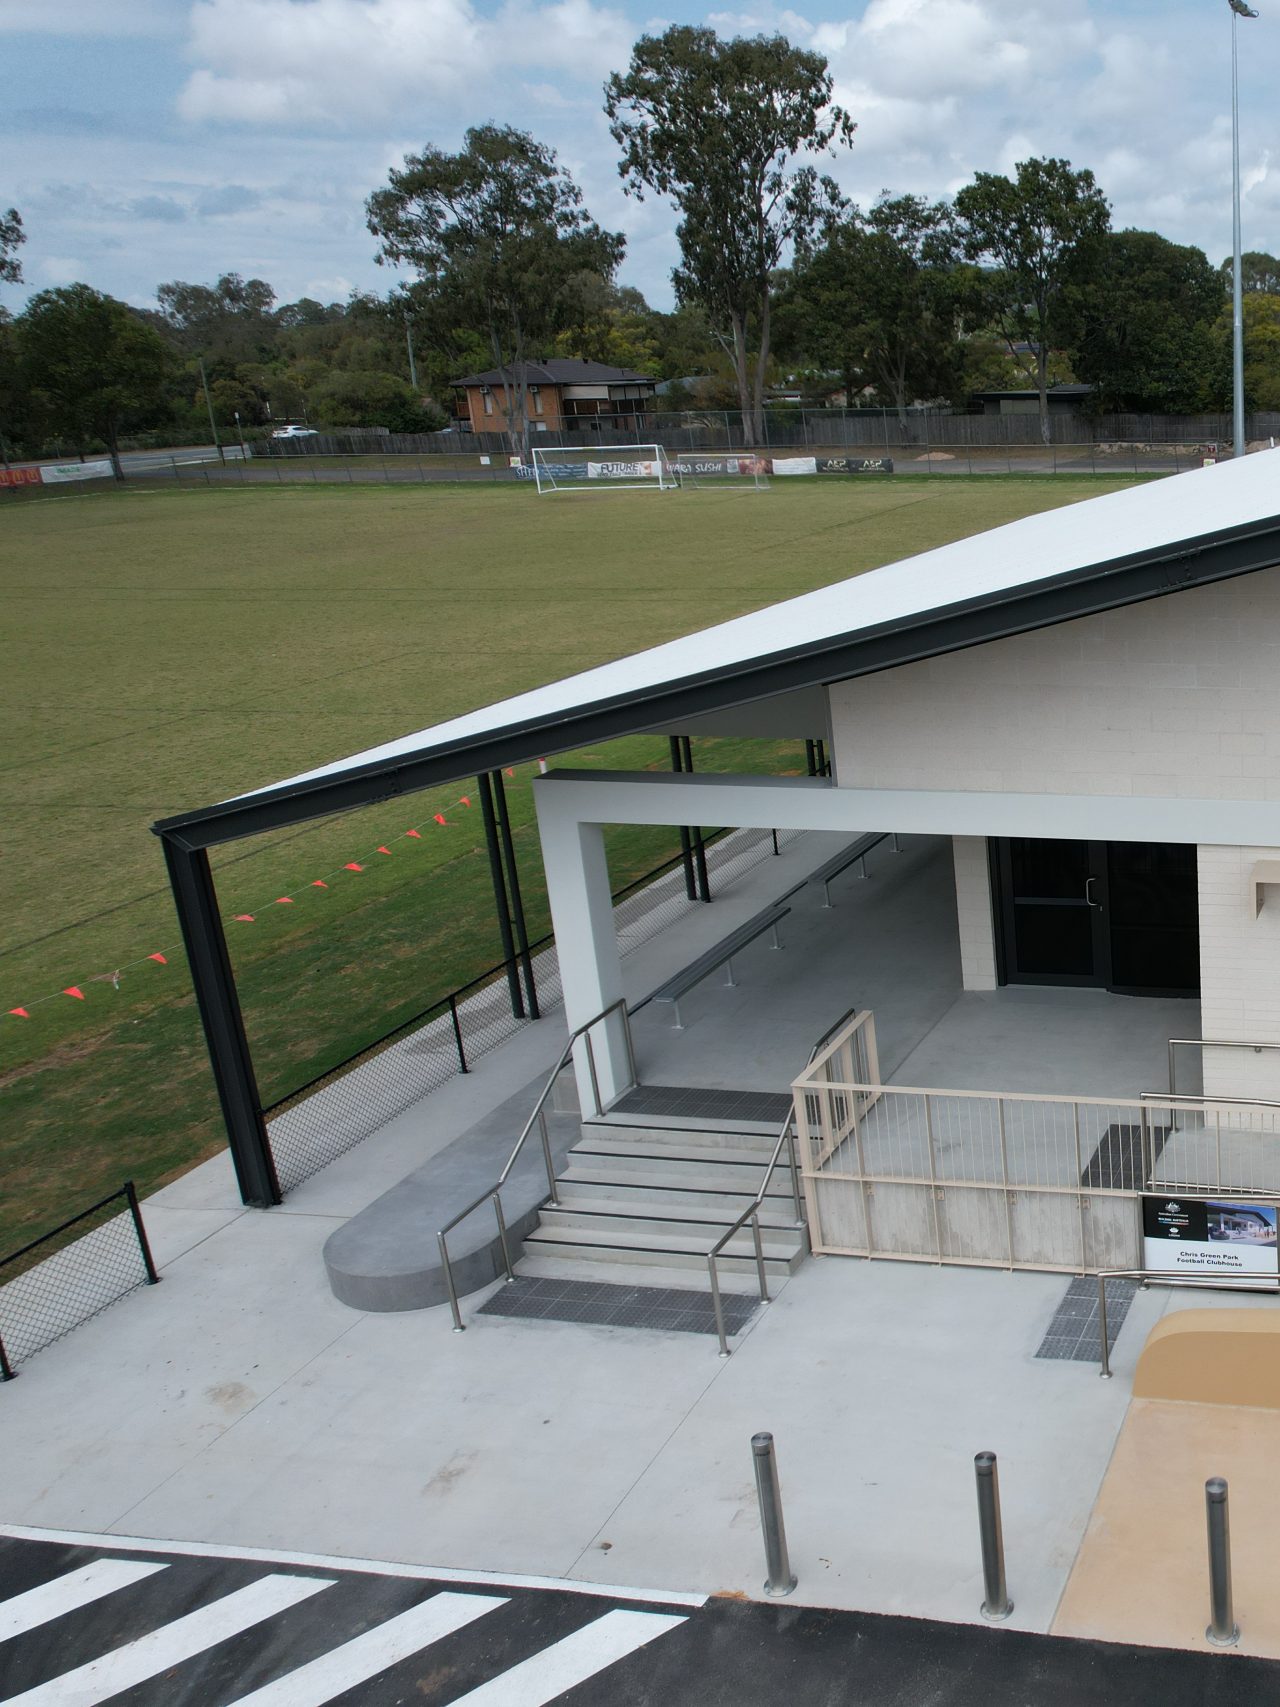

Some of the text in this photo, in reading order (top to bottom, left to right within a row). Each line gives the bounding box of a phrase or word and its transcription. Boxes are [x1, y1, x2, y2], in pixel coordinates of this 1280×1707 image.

[601, 463, 639, 473] FUTURE
[695, 463, 722, 473] SUSHI
[1206, 1259, 1243, 1267] Clubhouse
